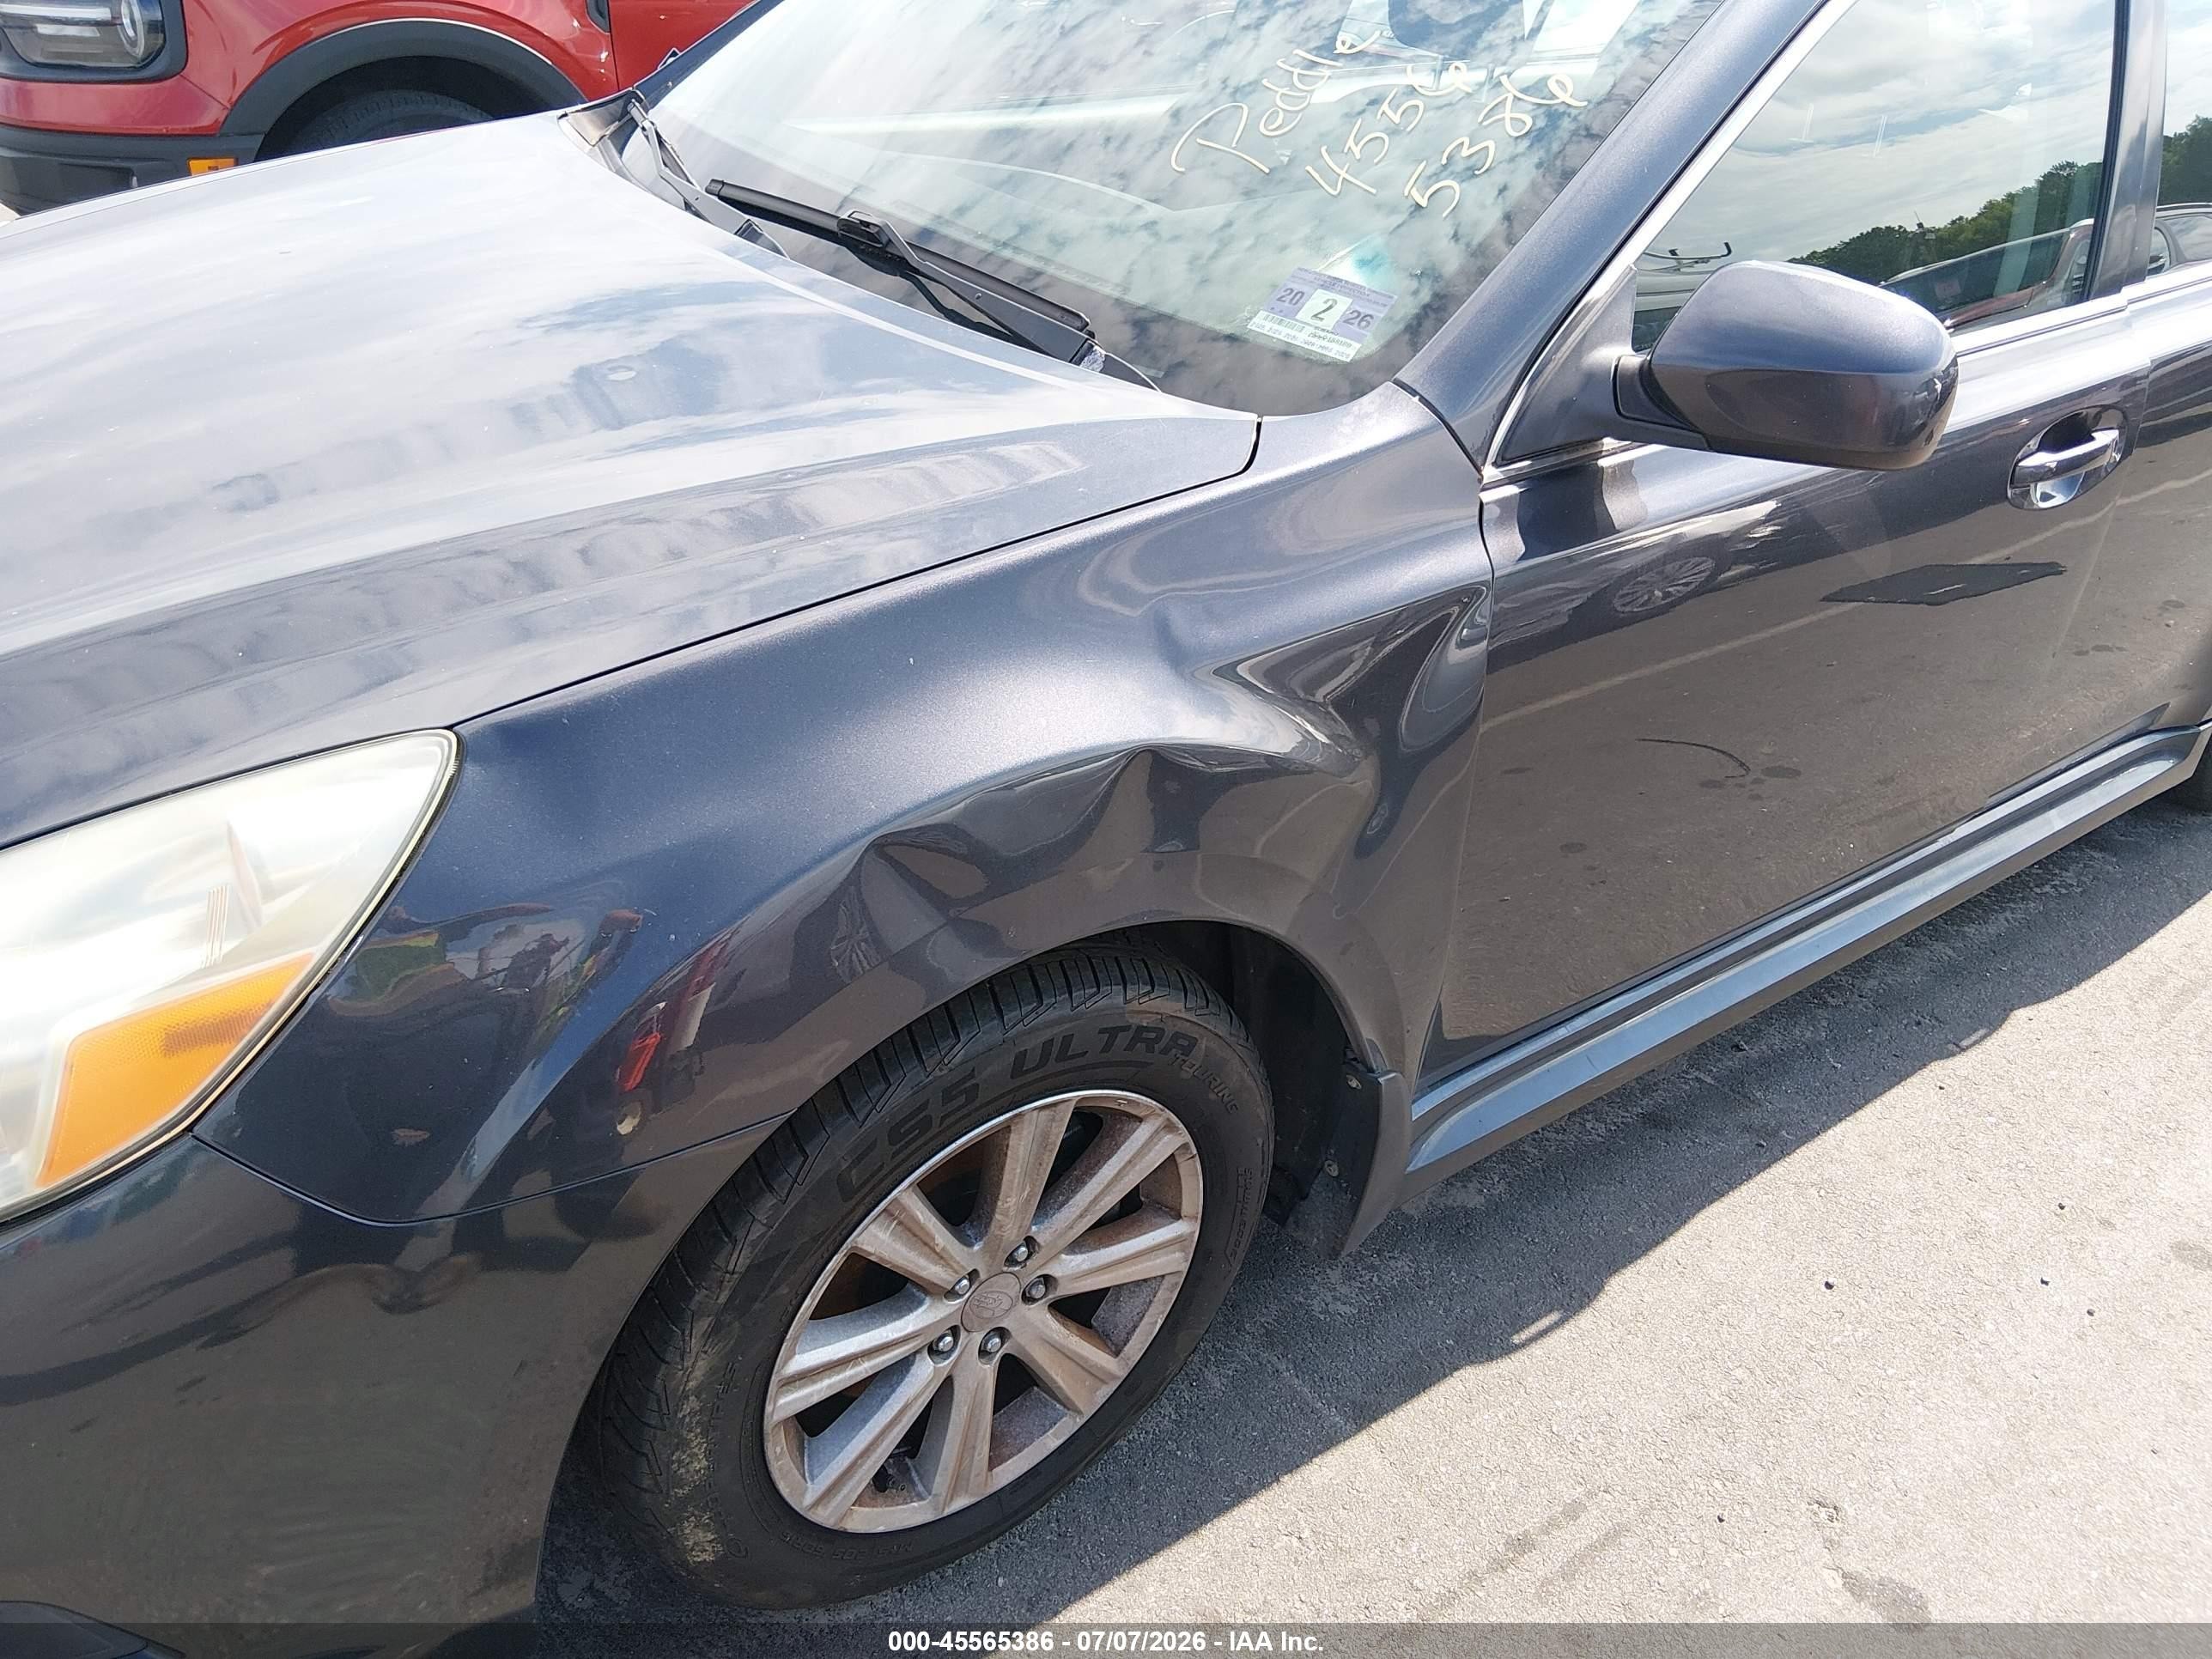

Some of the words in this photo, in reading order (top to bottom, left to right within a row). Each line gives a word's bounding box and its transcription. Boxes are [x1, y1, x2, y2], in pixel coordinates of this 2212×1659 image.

[1405, 74, 1588, 218] 5386
[1276, 288, 1305, 307] 20
[1310, 298, 1338, 323] 2
[1342, 309, 1375, 331] 26
[1010, 1025, 1203, 1079] ULTRA
